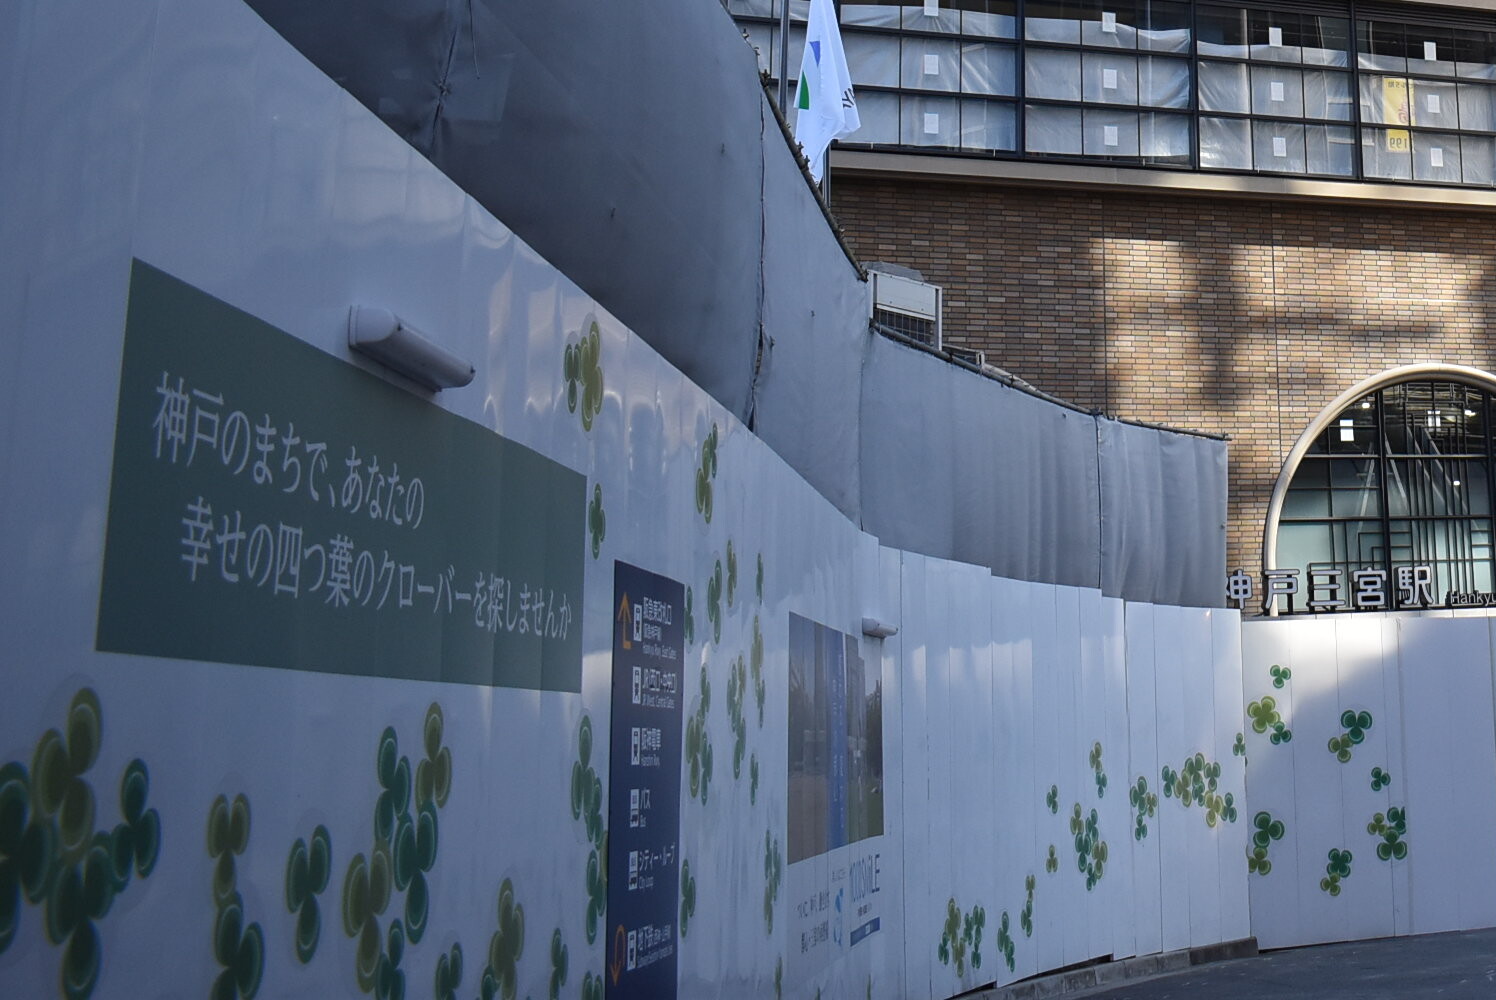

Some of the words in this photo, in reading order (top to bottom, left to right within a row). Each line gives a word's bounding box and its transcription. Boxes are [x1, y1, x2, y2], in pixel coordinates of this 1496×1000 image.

[153, 371, 425, 530] 神戸のまちで、あなたの
[181, 496, 573, 642] 幸せの四つ葉のクローバーを探しませんか
[1226, 565, 1434, 609] 神戸三宮駅
[640, 789, 651, 809] バス
